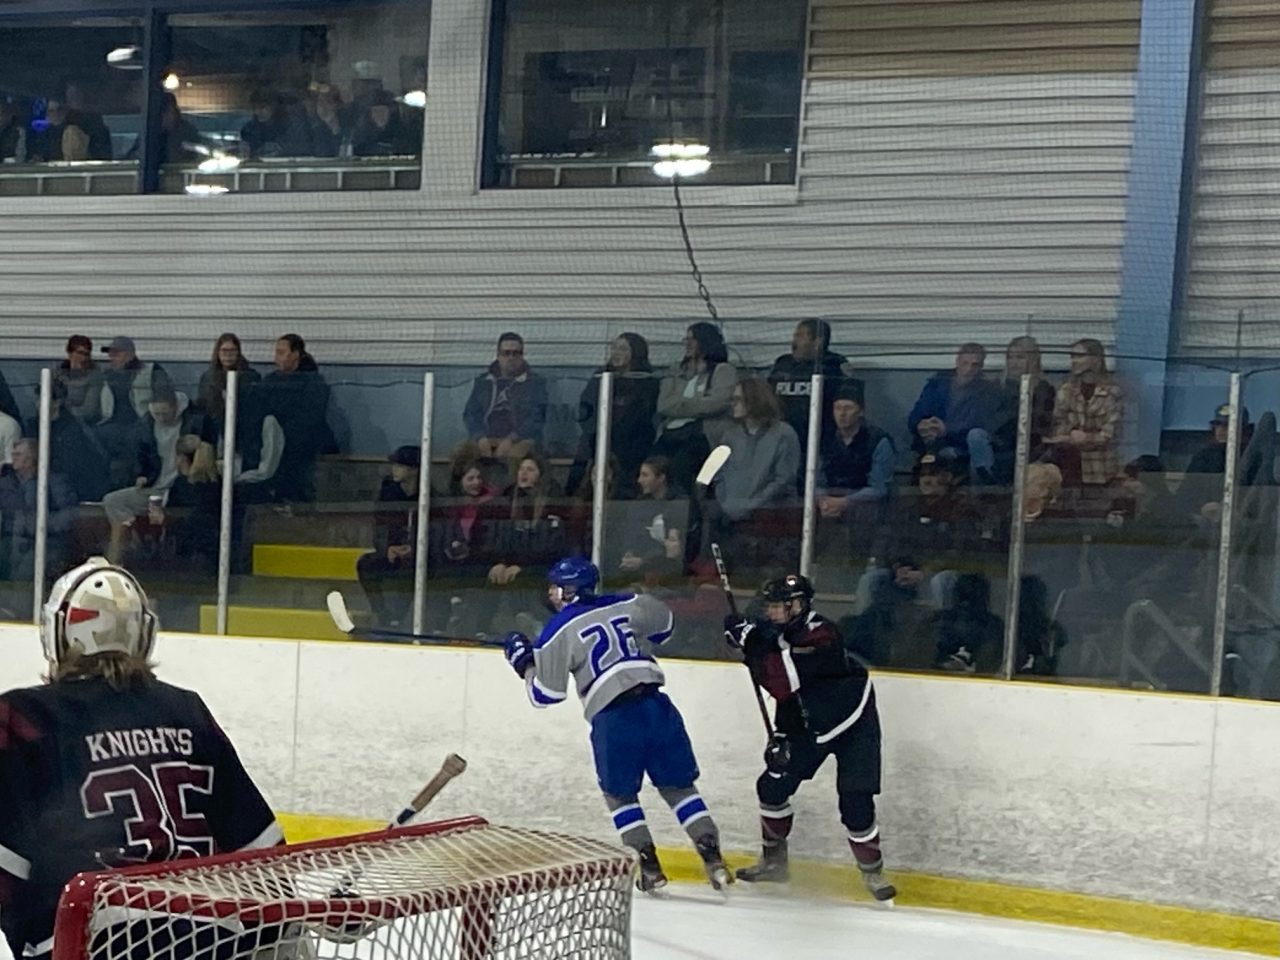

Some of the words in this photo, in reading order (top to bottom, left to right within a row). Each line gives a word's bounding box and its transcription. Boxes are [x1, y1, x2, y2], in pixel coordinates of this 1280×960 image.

[578, 615, 642, 678] 26
[85, 727, 193, 762] KNIGHTS
[80, 761, 214, 869] 35
